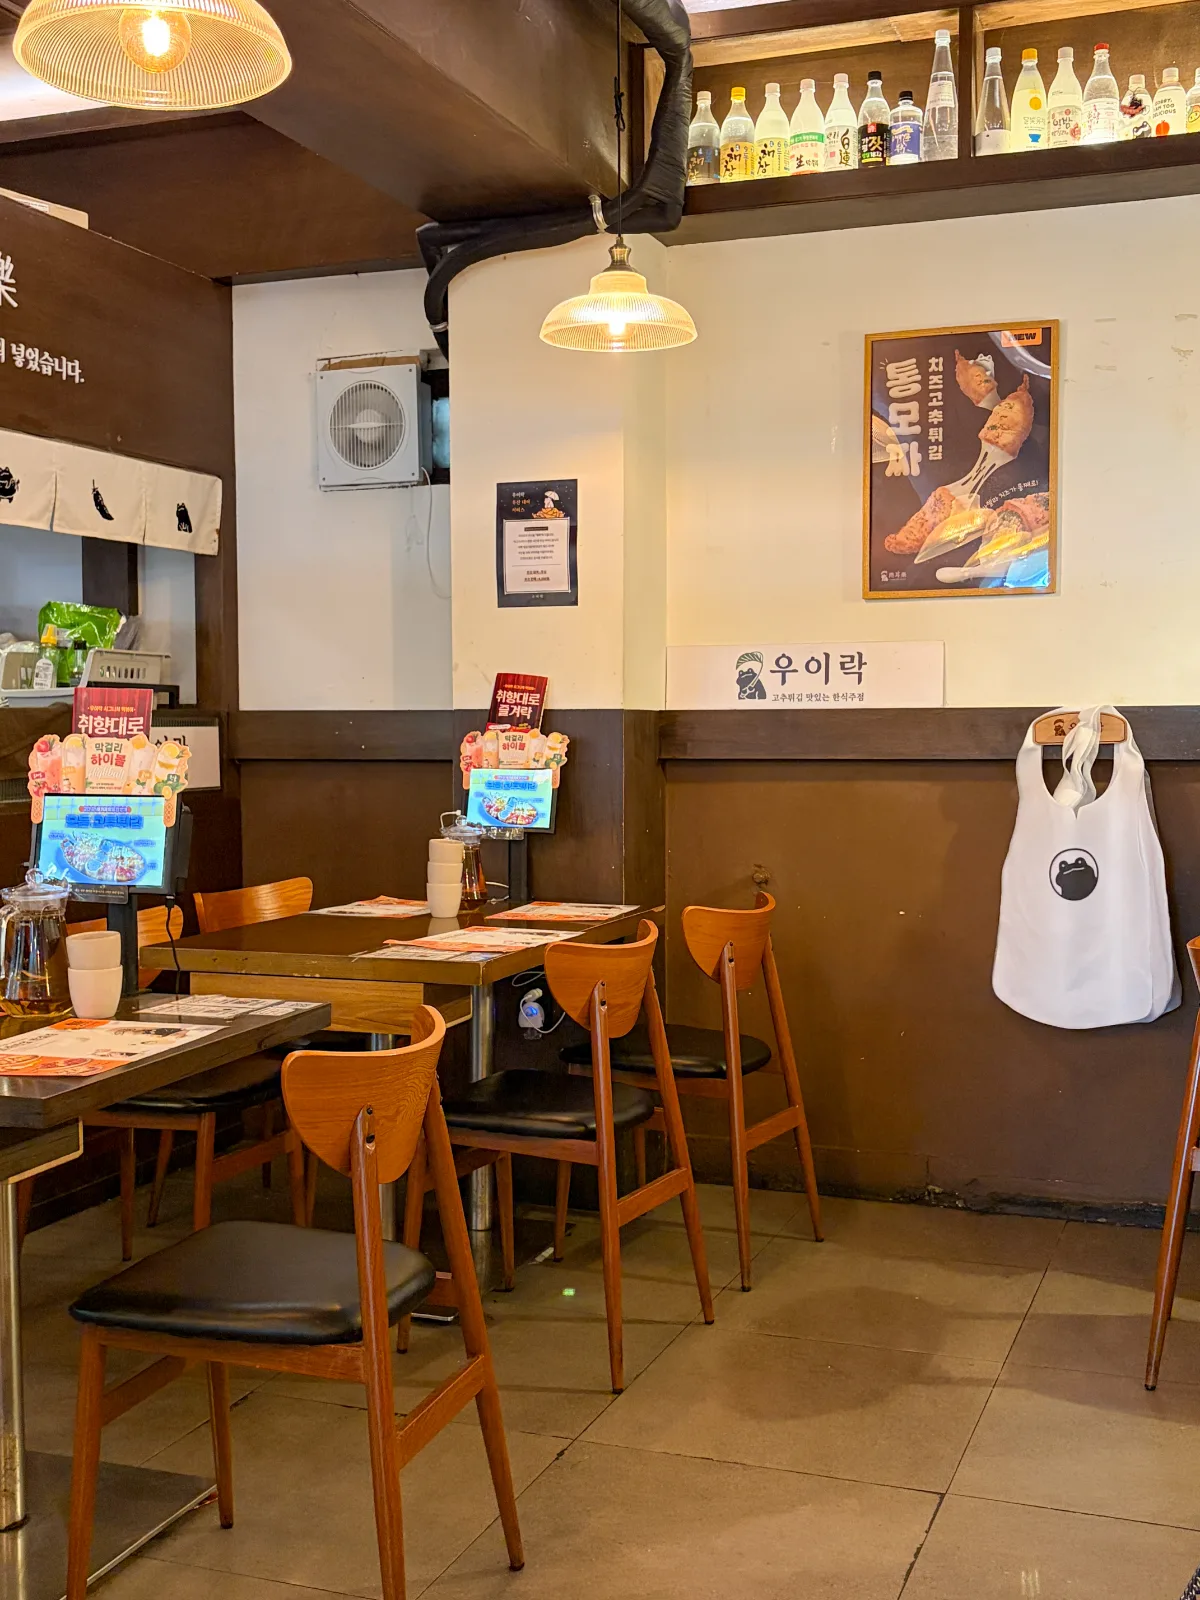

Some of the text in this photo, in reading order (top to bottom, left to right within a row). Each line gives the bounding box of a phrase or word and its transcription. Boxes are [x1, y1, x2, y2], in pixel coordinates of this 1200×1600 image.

[10, 343, 85, 384] 넣었습니다.
[928, 357, 944, 461] 치즈고추튀김
[770, 651, 868, 686] 우이락
[496, 689, 540, 705] 취향대로
[772, 692, 865, 702] 고추튀김 맛있는 한식주점
[498, 704, 532, 720] 즐겨락
[77, 714, 144, 736] 취향대로
[95, 742, 123, 753] 막걸리
[91, 754, 126, 767] 하이볼
